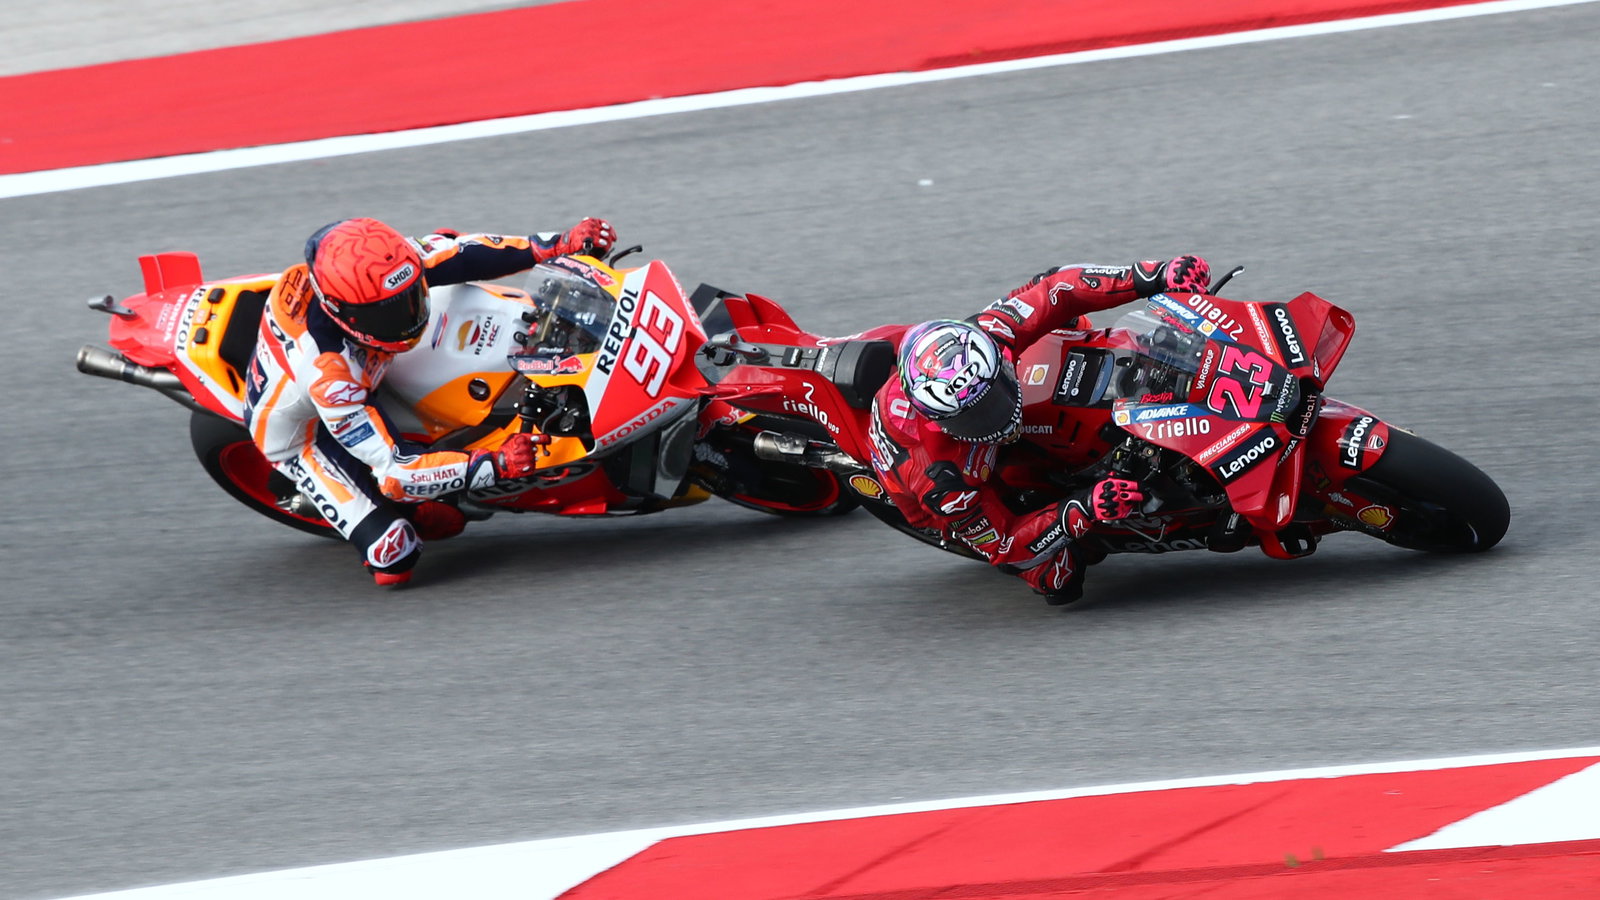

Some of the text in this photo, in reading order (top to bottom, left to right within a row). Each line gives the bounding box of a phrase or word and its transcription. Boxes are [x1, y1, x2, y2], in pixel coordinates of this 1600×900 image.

[387, 266, 412, 288] SHOEI
[474, 315, 493, 355] REPSOL
[596, 288, 639, 375] REPSOL
[622, 288, 685, 400] 93
[1275, 308, 1304, 363] Lenovo
[1058, 360, 1076, 395] Lenovo
[1207, 345, 1274, 419] 23
[1276, 373, 1294, 412] MONSTER
[600, 400, 678, 447] HONDA
[1136, 405, 1189, 421] ADVANCE
[1157, 418, 1210, 439] riello
[1200, 423, 1251, 462] FRECCIAROSSA
[1219, 436, 1275, 478] Lenovo
[1344, 416, 1373, 467] Lenovo
[403, 477, 464, 496] REPSO
[411, 472, 432, 484] Satu
